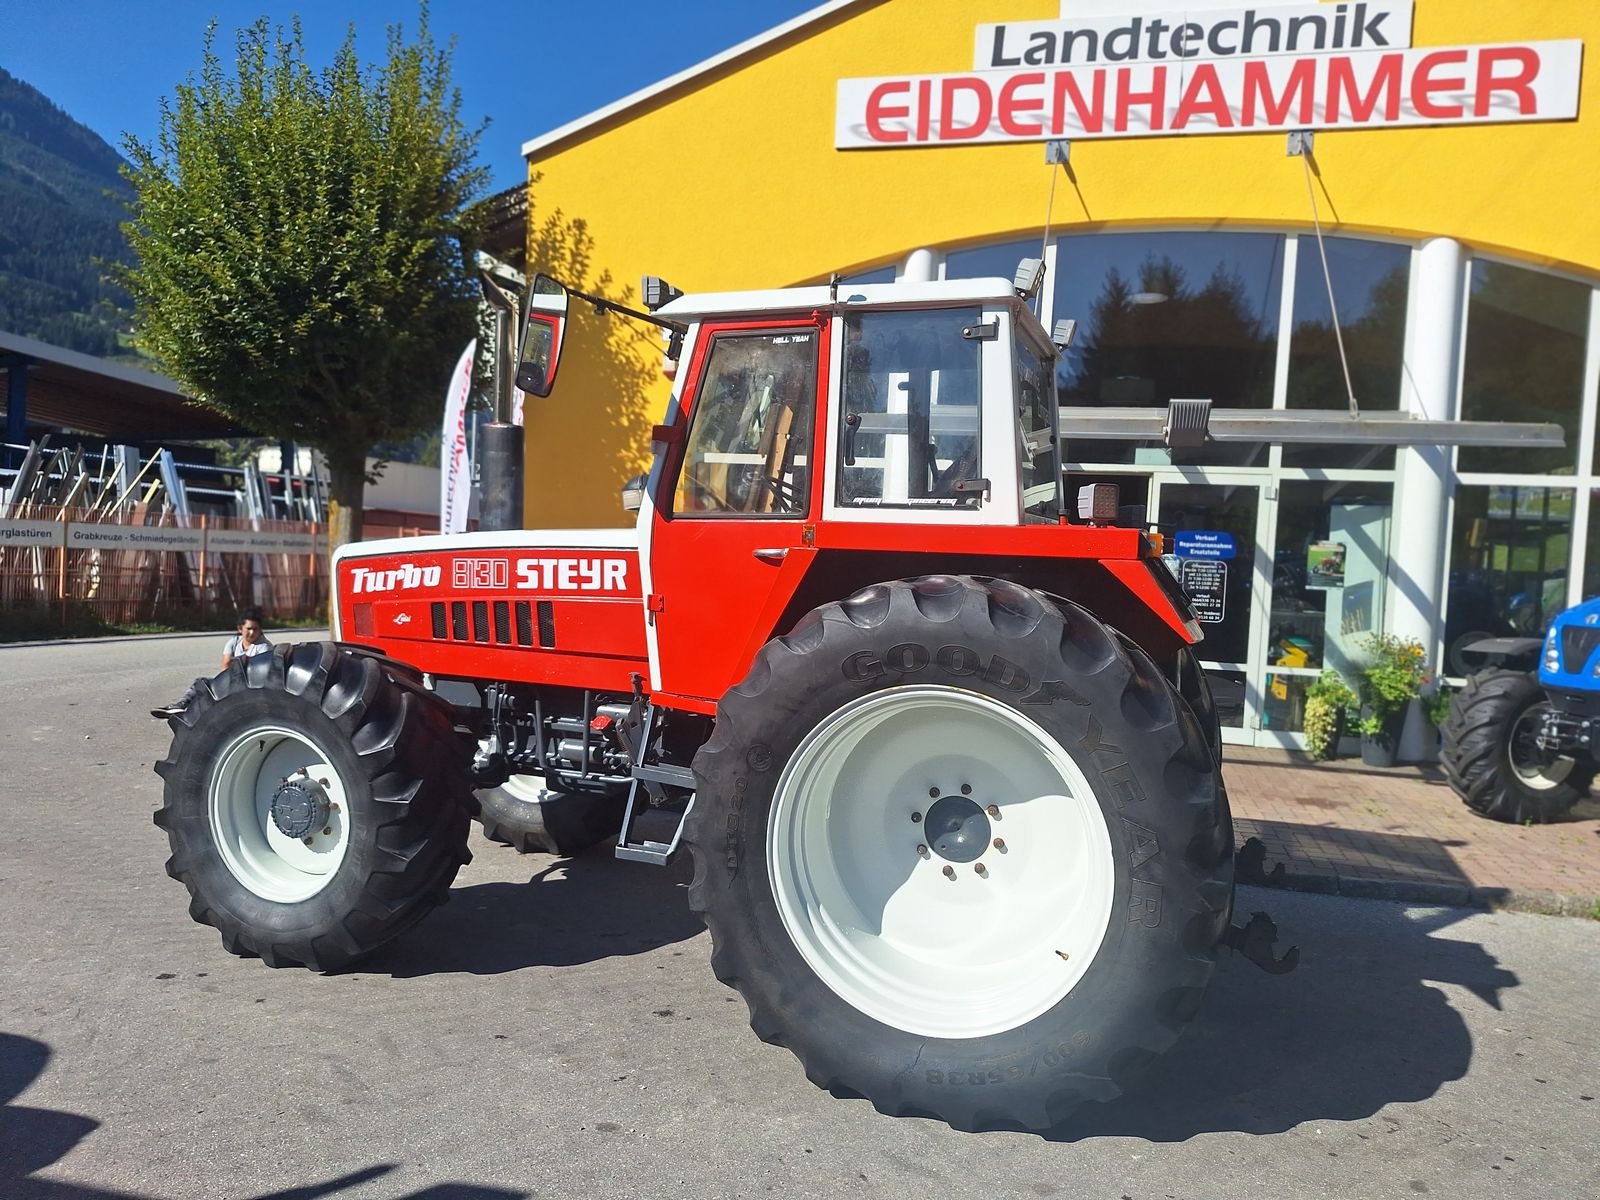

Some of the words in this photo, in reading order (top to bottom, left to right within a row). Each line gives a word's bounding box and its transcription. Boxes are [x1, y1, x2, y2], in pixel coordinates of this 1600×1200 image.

[990, 3, 1390, 67] Landtechnik
[866, 47, 1541, 142] EIDENHAMMER
[0, 528, 52, 539] rglastüren
[74, 531, 123, 541] Grabkreuze
[1179, 541, 1232, 549] Reparaturannahme
[351, 564, 441, 593] Turbo
[453, 558, 508, 588] 8130
[516, 559, 627, 590] STEYR
